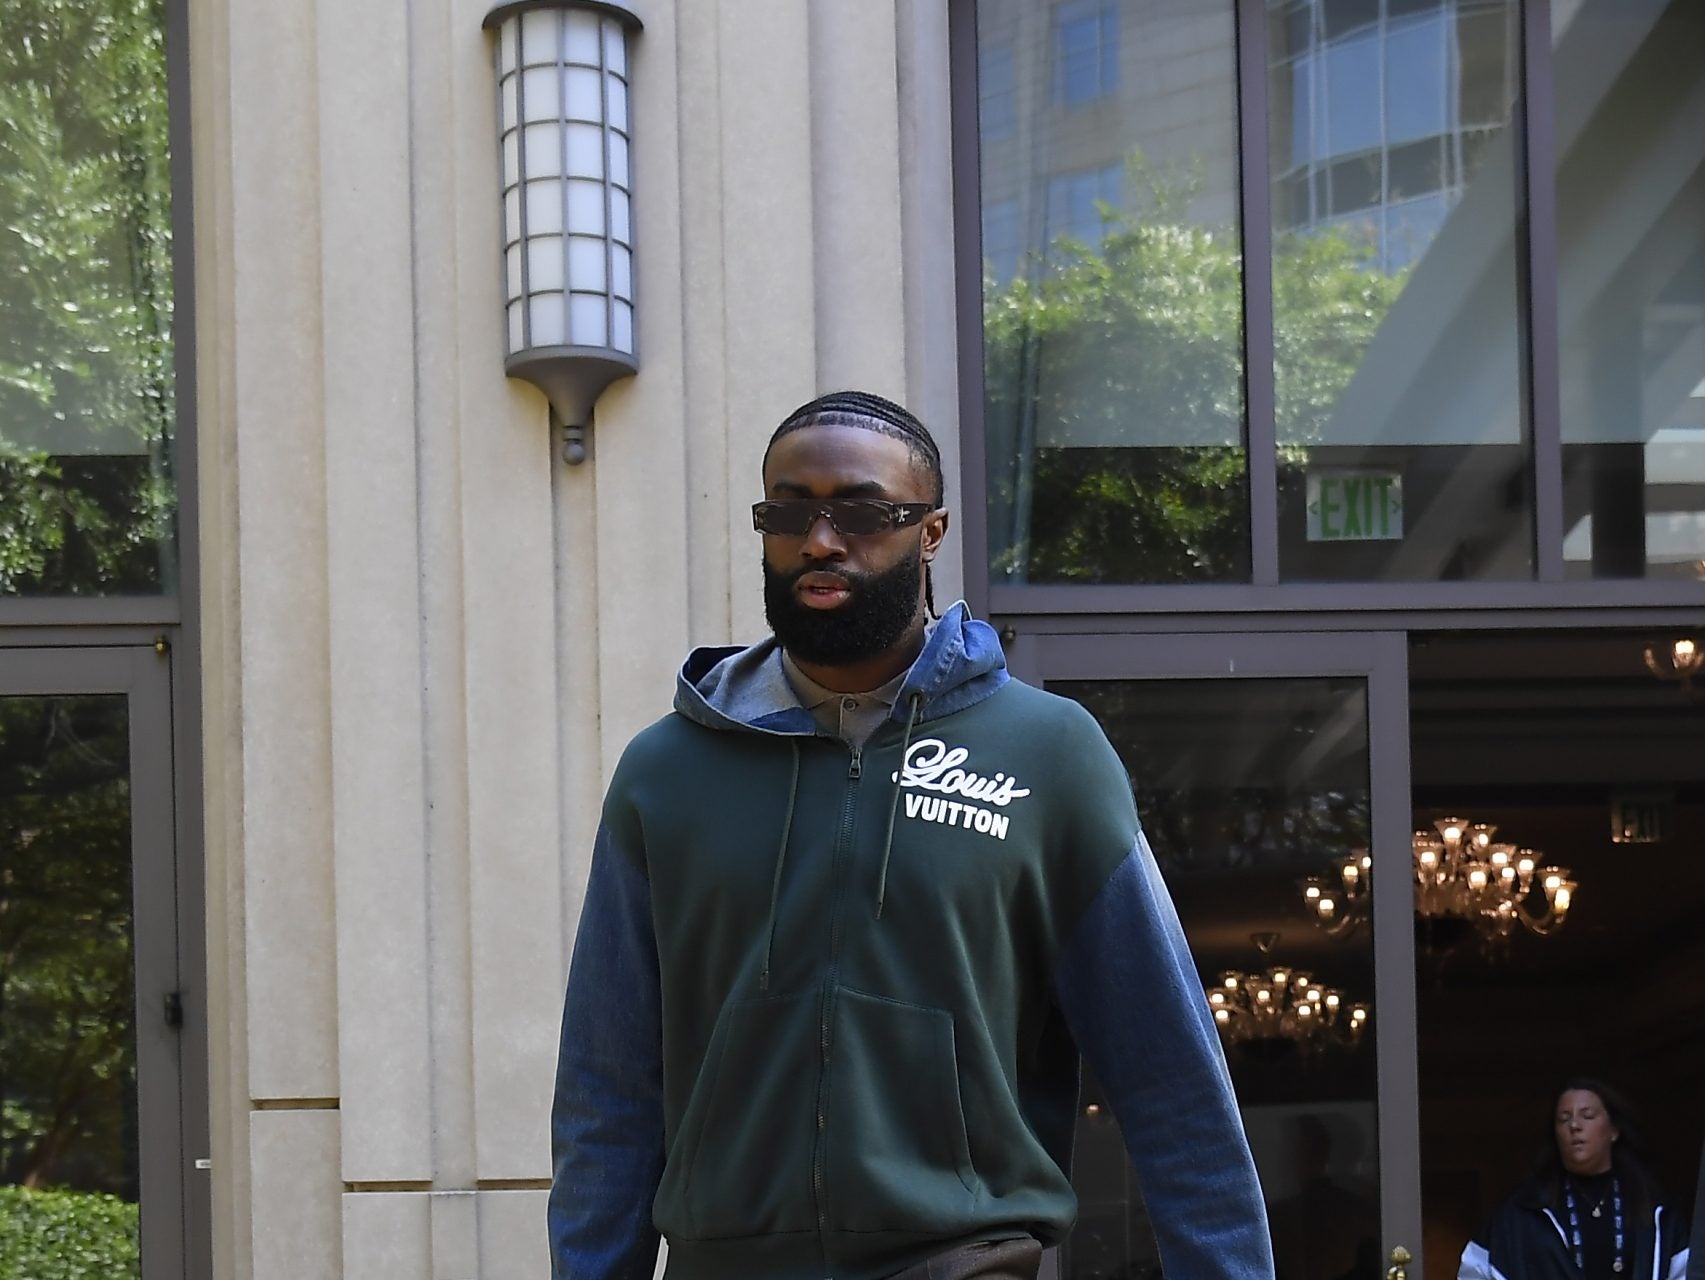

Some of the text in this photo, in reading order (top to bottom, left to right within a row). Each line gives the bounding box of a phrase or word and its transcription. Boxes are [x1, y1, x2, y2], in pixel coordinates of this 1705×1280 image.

[1321, 478, 1392, 538] EXIT
[891, 738, 1031, 806] Louis
[905, 793, 1010, 840] VUITTON
